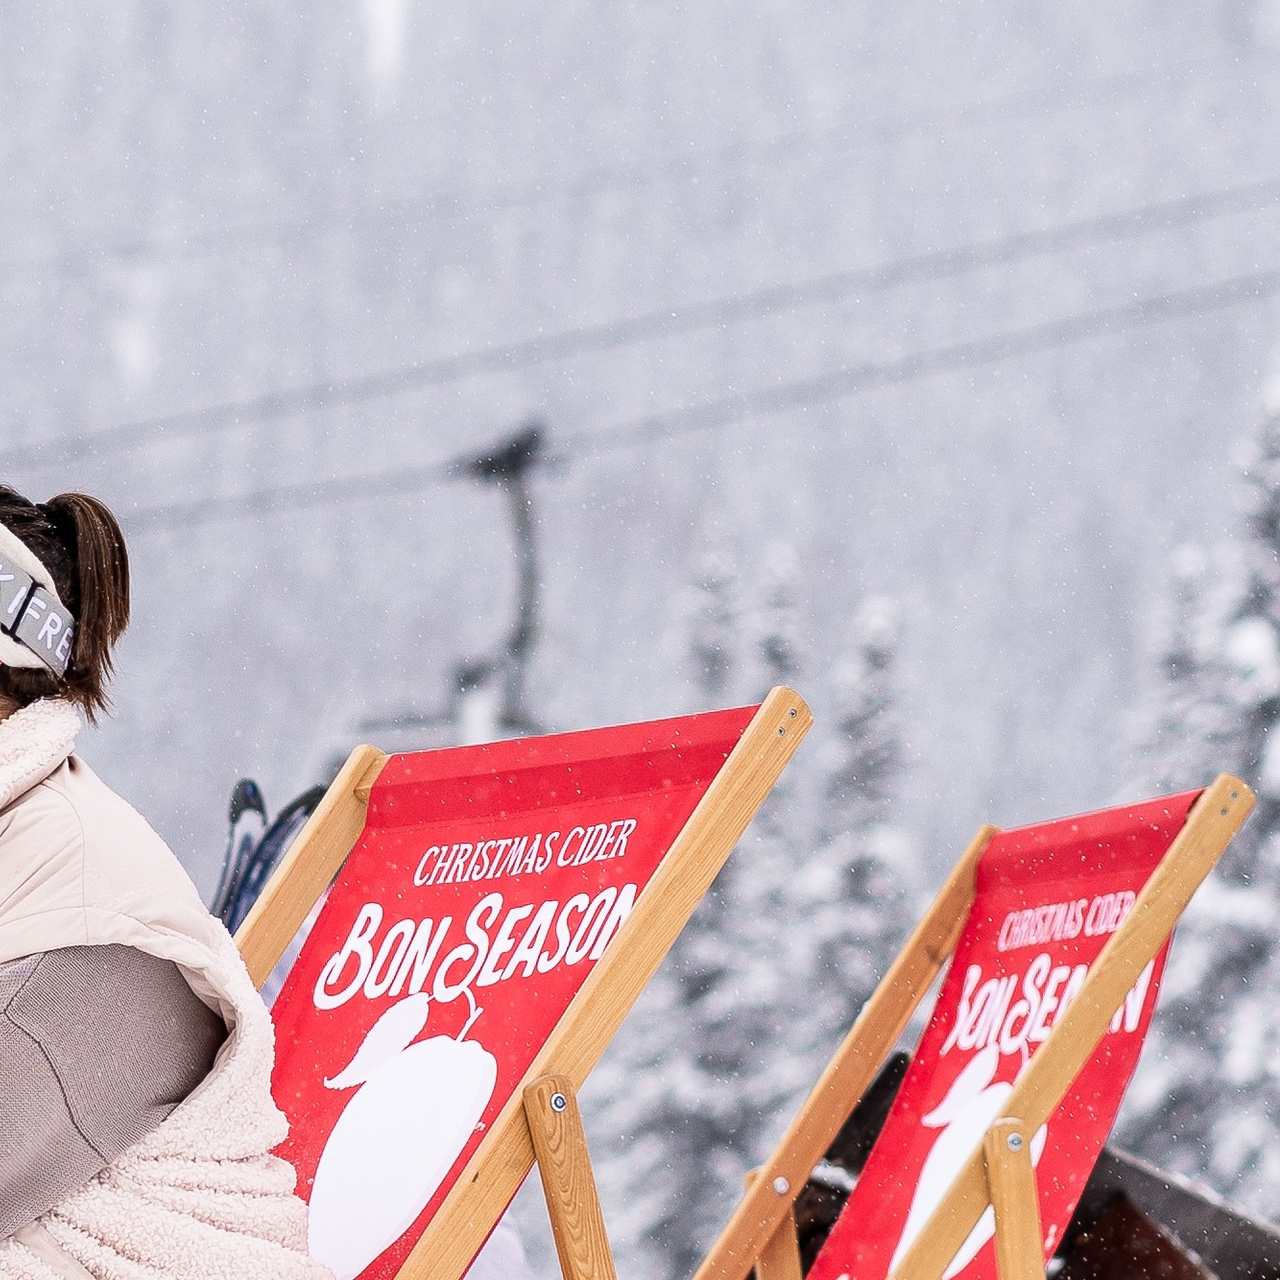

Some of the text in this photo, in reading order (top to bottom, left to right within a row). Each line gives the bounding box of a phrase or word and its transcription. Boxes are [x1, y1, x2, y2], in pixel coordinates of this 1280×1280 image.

[413, 818, 638, 887] CHRISTMAS CIDER
[312, 901, 453, 1011] BON
